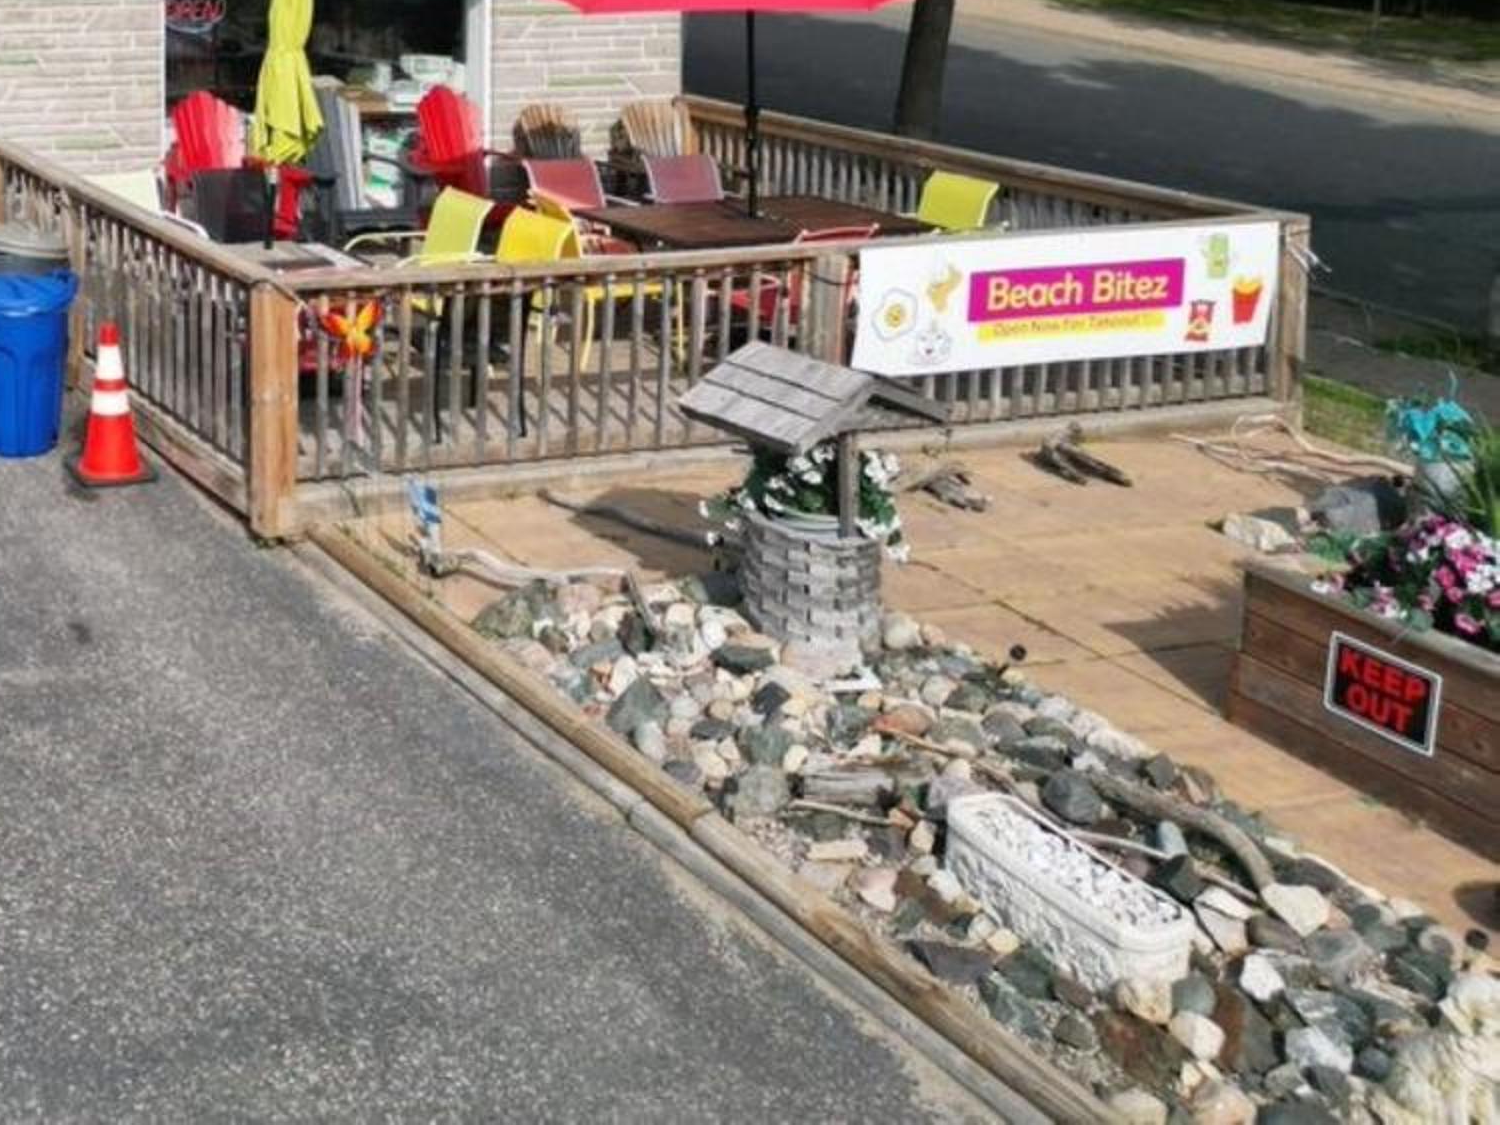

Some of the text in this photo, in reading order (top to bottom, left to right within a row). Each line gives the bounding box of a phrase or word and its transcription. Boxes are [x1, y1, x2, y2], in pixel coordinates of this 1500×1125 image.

[986, 265, 1169, 312] Beach Bitez
[1341, 650, 1426, 700] KEEP
[1347, 685, 1412, 732] OUT
